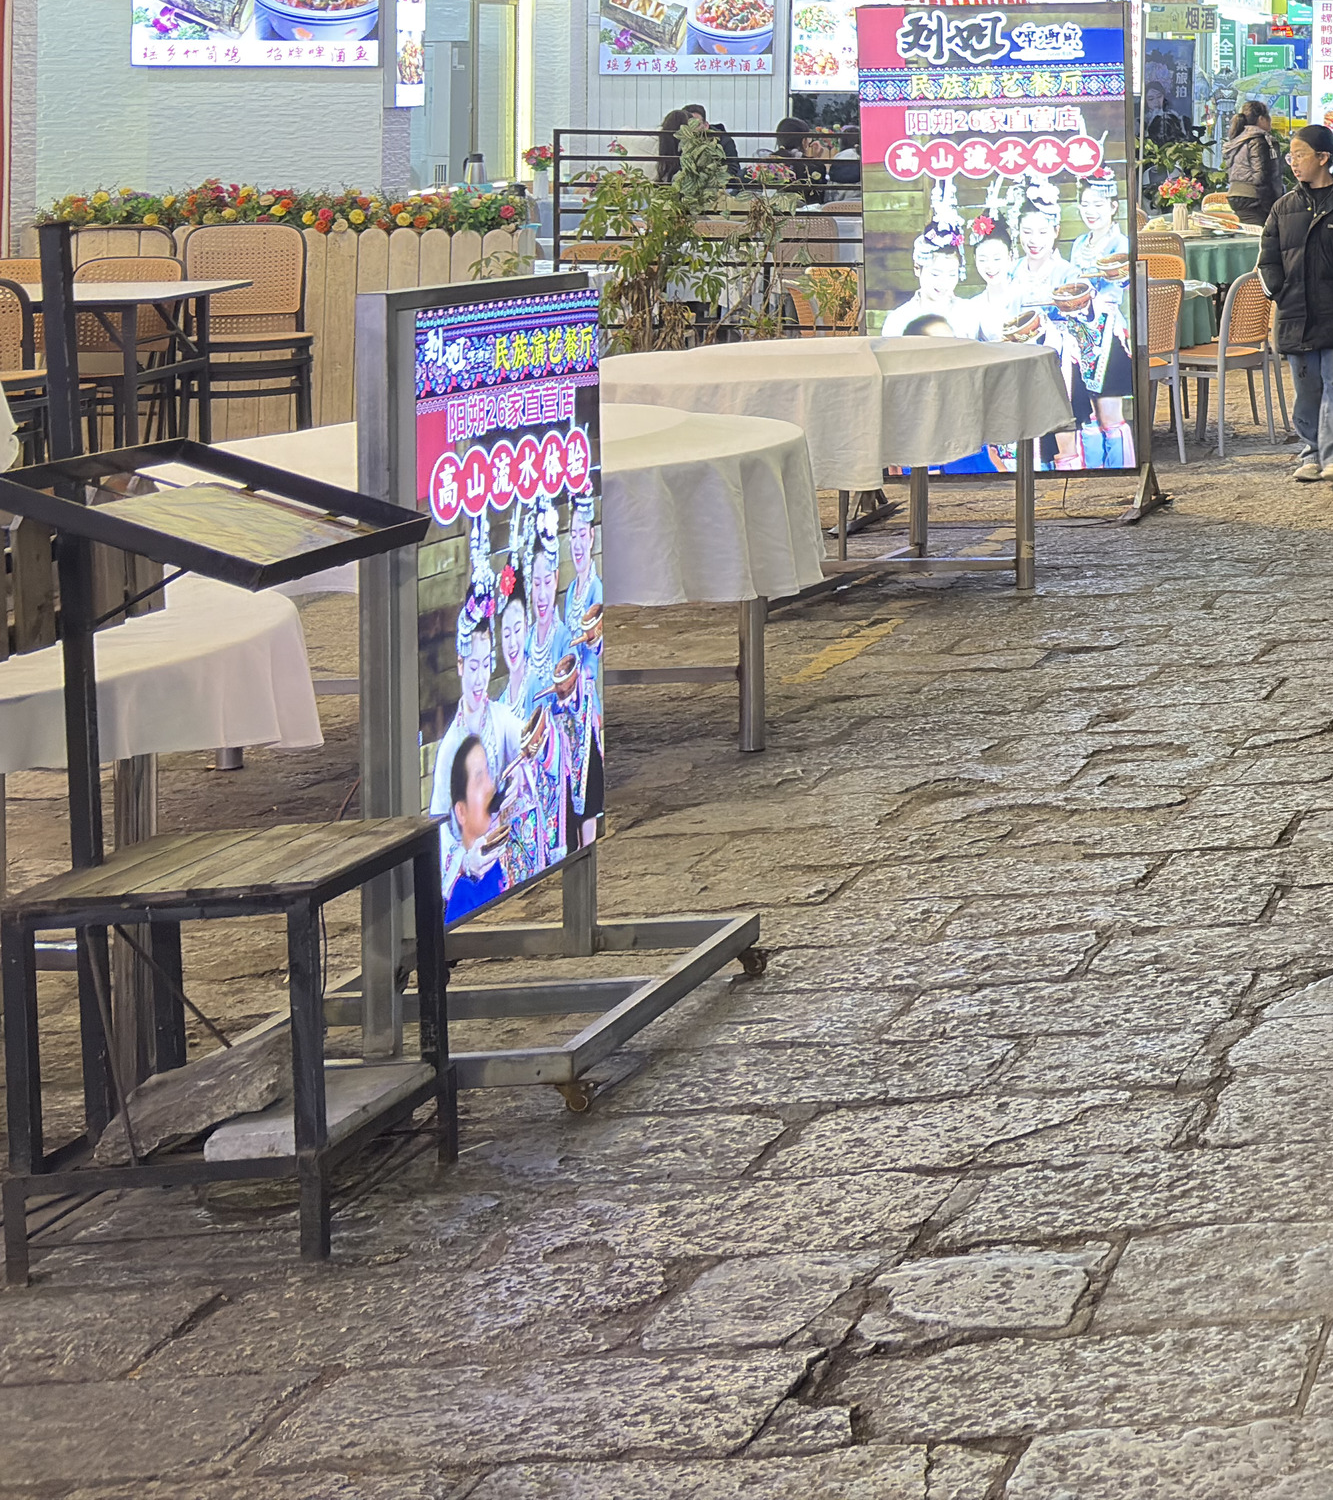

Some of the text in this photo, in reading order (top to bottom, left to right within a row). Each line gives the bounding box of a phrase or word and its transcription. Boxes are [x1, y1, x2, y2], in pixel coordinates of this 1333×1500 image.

[1185, 6, 1215, 31] 烟酒
[266, 45, 370, 64] 招牌啤酒鱼
[606, 57, 767, 73] 瑶乡竹筒鸡 招牌啤酒鱼
[910, 70, 1084, 100] 民族演艺餐厅
[906, 106, 1081, 135] 阳朔26家直营店
[894, 142, 1097, 174] 高山流水体验
[494, 325, 593, 372] 民族演艺餐厅
[446, 383, 576, 442] 阳朔26家直营店
[437, 438, 587, 510] 高山流水体验
